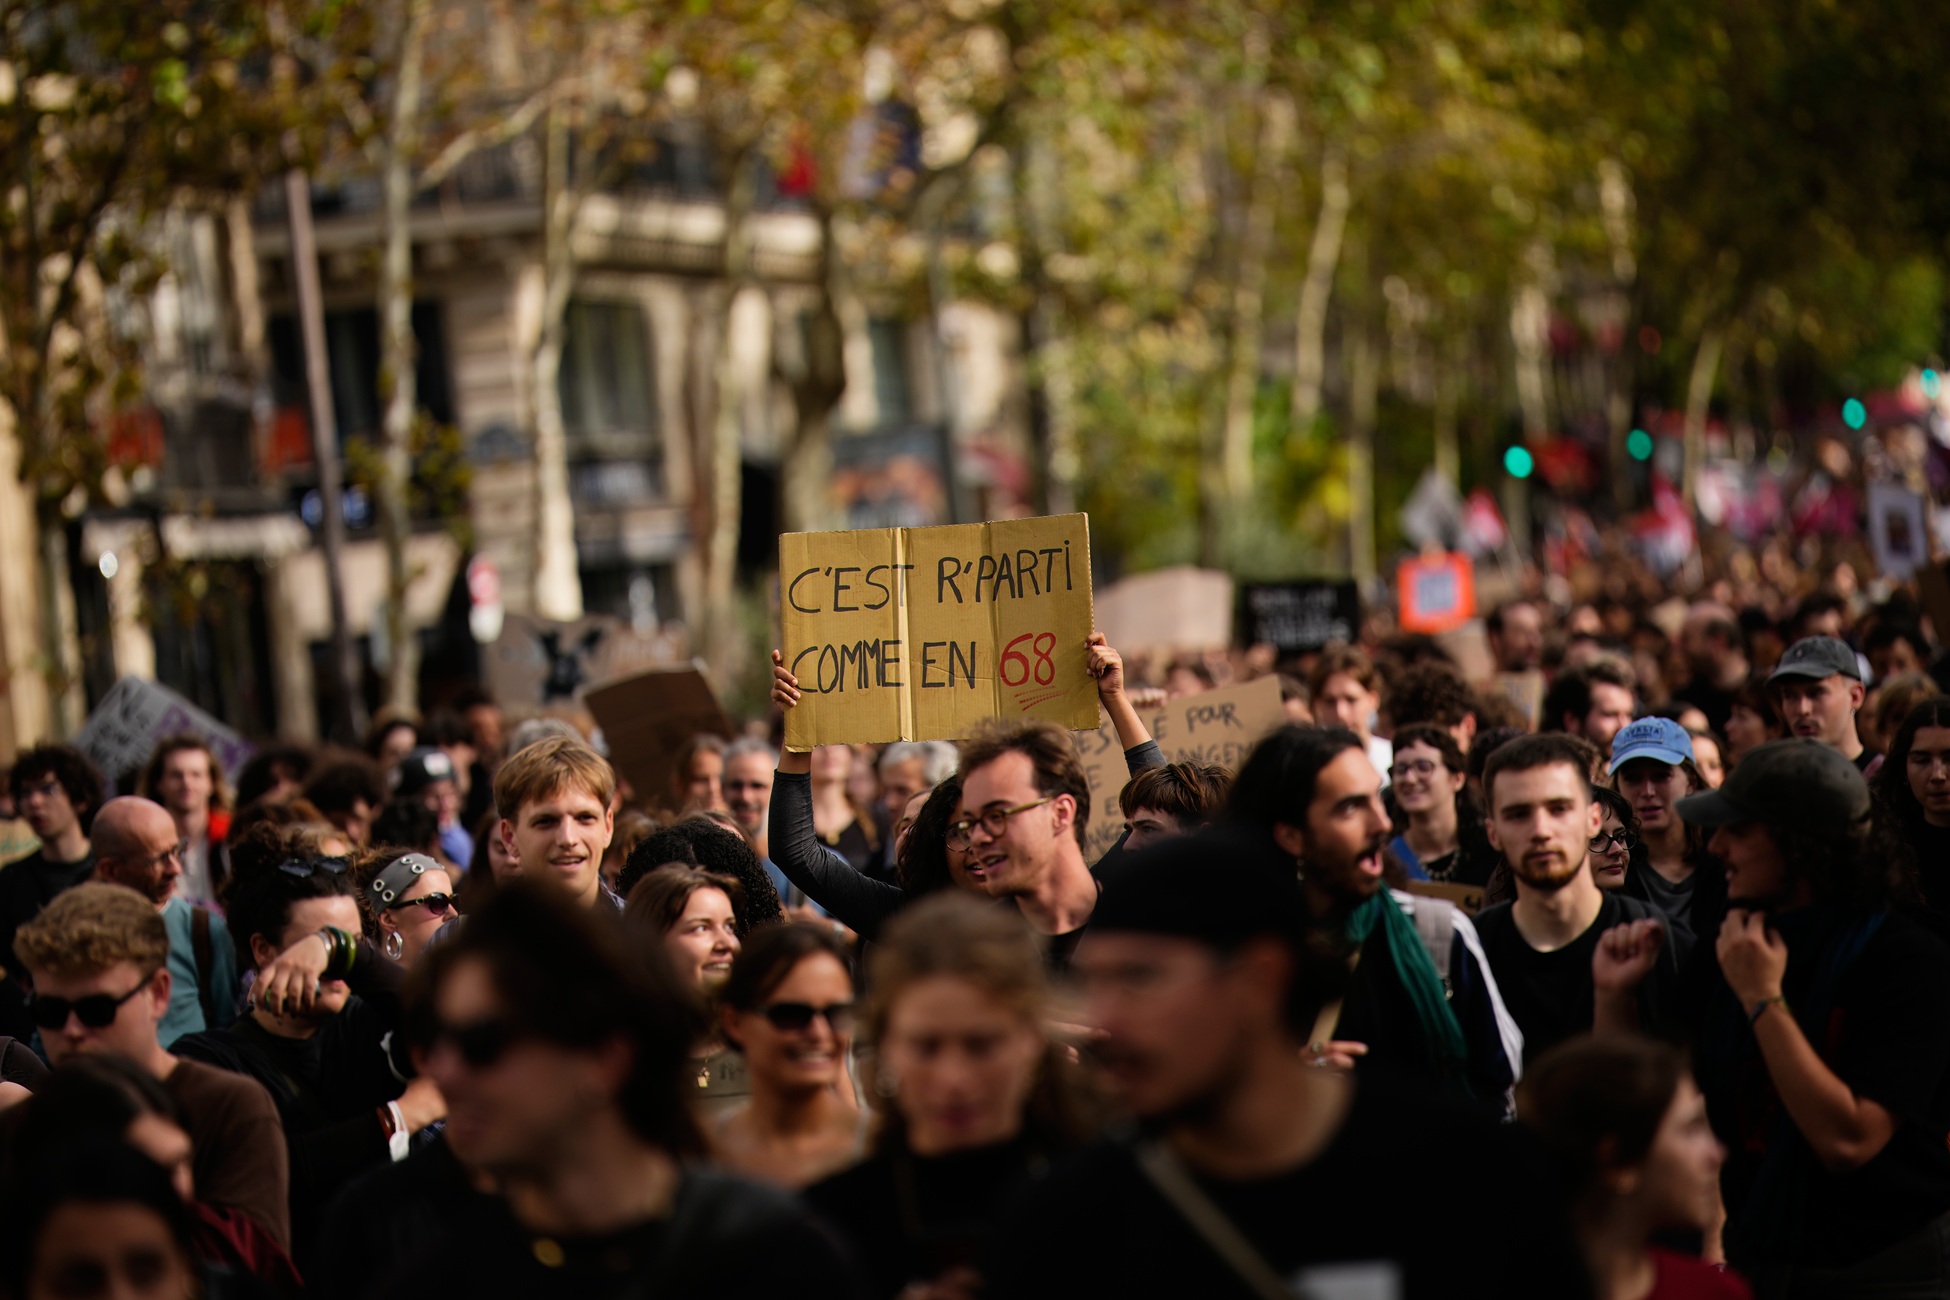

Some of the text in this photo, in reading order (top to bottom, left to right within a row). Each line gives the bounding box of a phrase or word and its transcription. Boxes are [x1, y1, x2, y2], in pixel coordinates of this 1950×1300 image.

[789, 564, 915, 614] C'EST
[791, 632, 1057, 694] COMME EN 68
[1185, 702, 1244, 734] POUR
